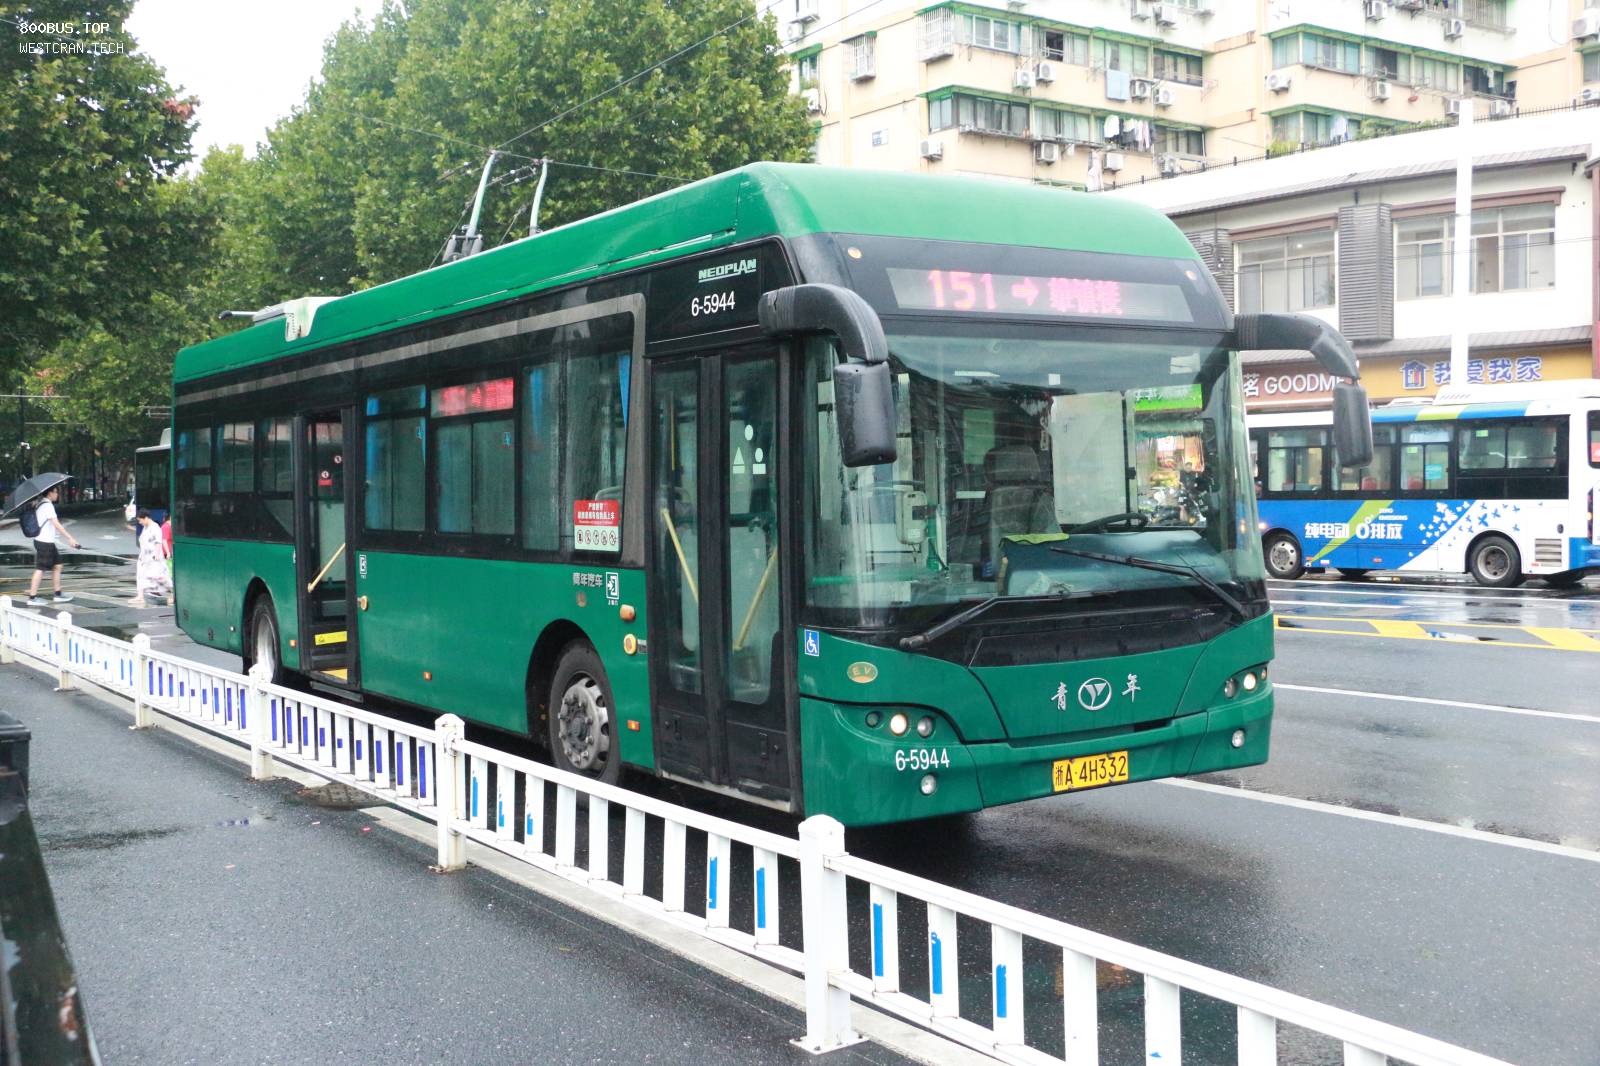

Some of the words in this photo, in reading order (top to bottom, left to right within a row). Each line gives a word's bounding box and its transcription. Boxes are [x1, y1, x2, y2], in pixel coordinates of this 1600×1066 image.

[698, 258, 757, 282] NEOPLAN
[928, 269, 996, 311] 151
[691, 290, 736, 317] 6-5944
[1304, 522, 1350, 539] 纯电动
[895, 748, 950, 771] 6-5944
